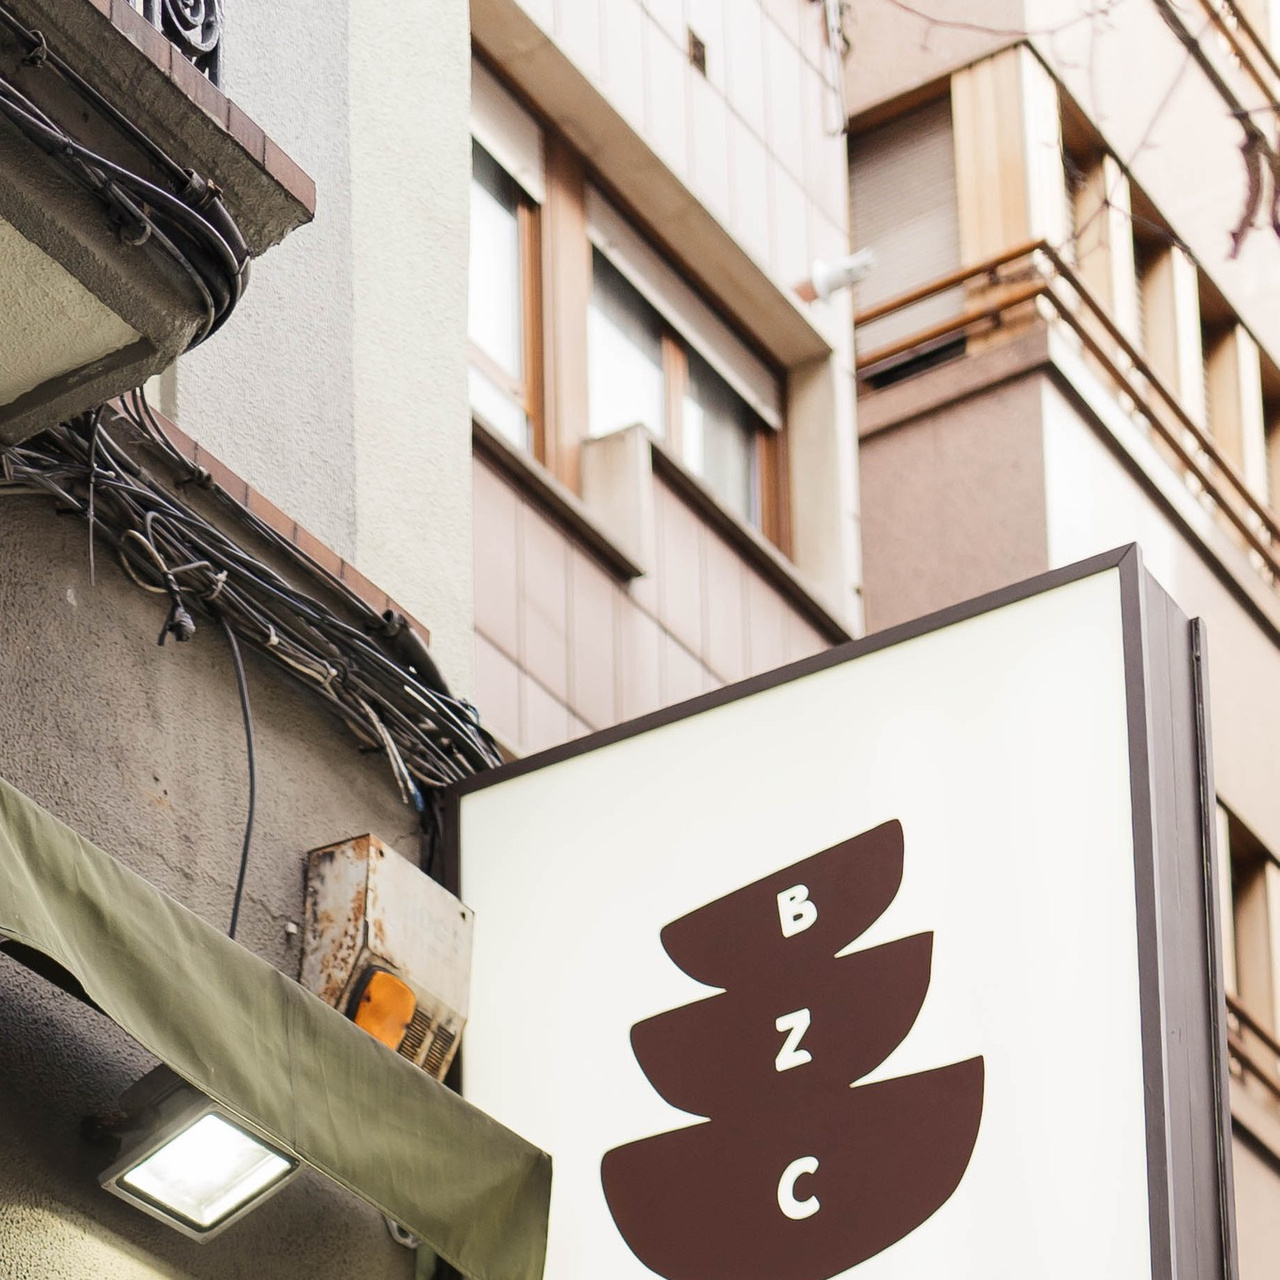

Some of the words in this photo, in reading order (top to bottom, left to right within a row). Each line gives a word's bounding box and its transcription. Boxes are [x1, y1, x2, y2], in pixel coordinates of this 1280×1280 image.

[776, 884, 818, 939] B
[774, 1009, 812, 1073] Z
[777, 1155, 820, 1221] C
